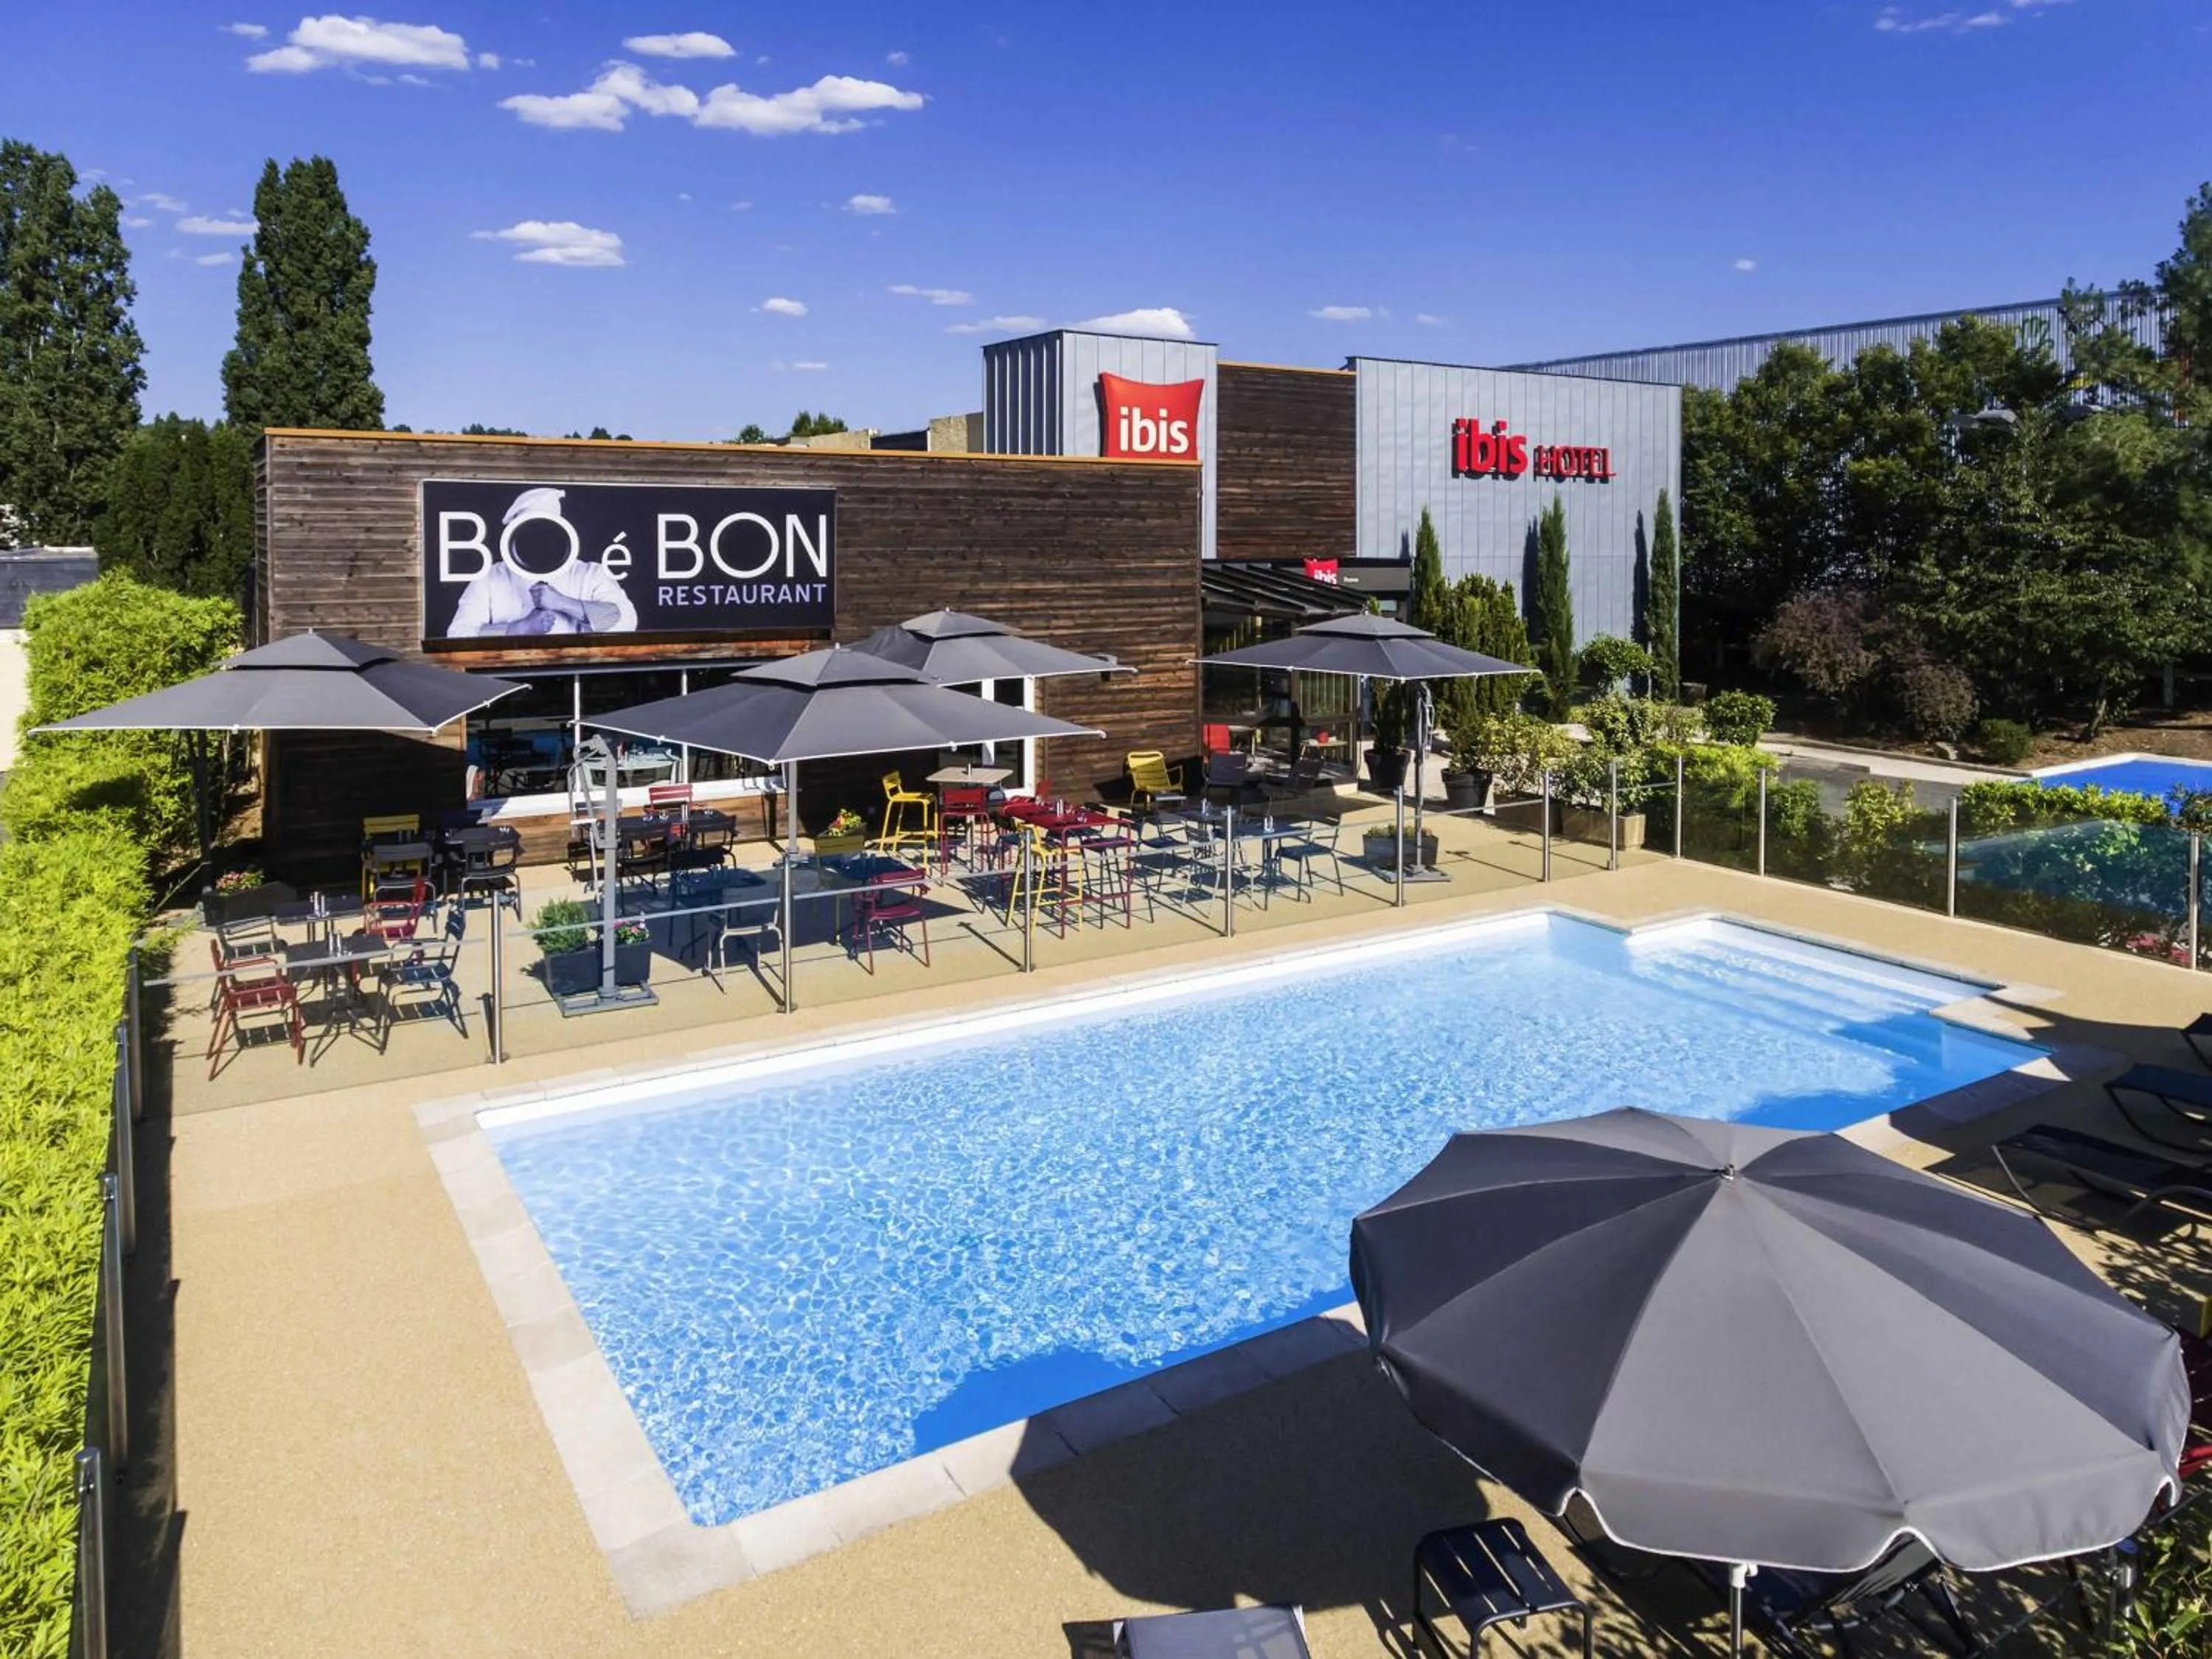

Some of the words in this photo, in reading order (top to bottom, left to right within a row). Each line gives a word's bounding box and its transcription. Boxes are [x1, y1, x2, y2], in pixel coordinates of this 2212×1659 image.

[1120, 406, 1189, 453] ibis
[1455, 417, 1528, 474] ibis
[1536, 445, 1616, 478] HOTEL
[601, 531, 632, 580] é
[657, 512, 827, 580] BON
[658, 584, 827, 606] RESTAURANT
